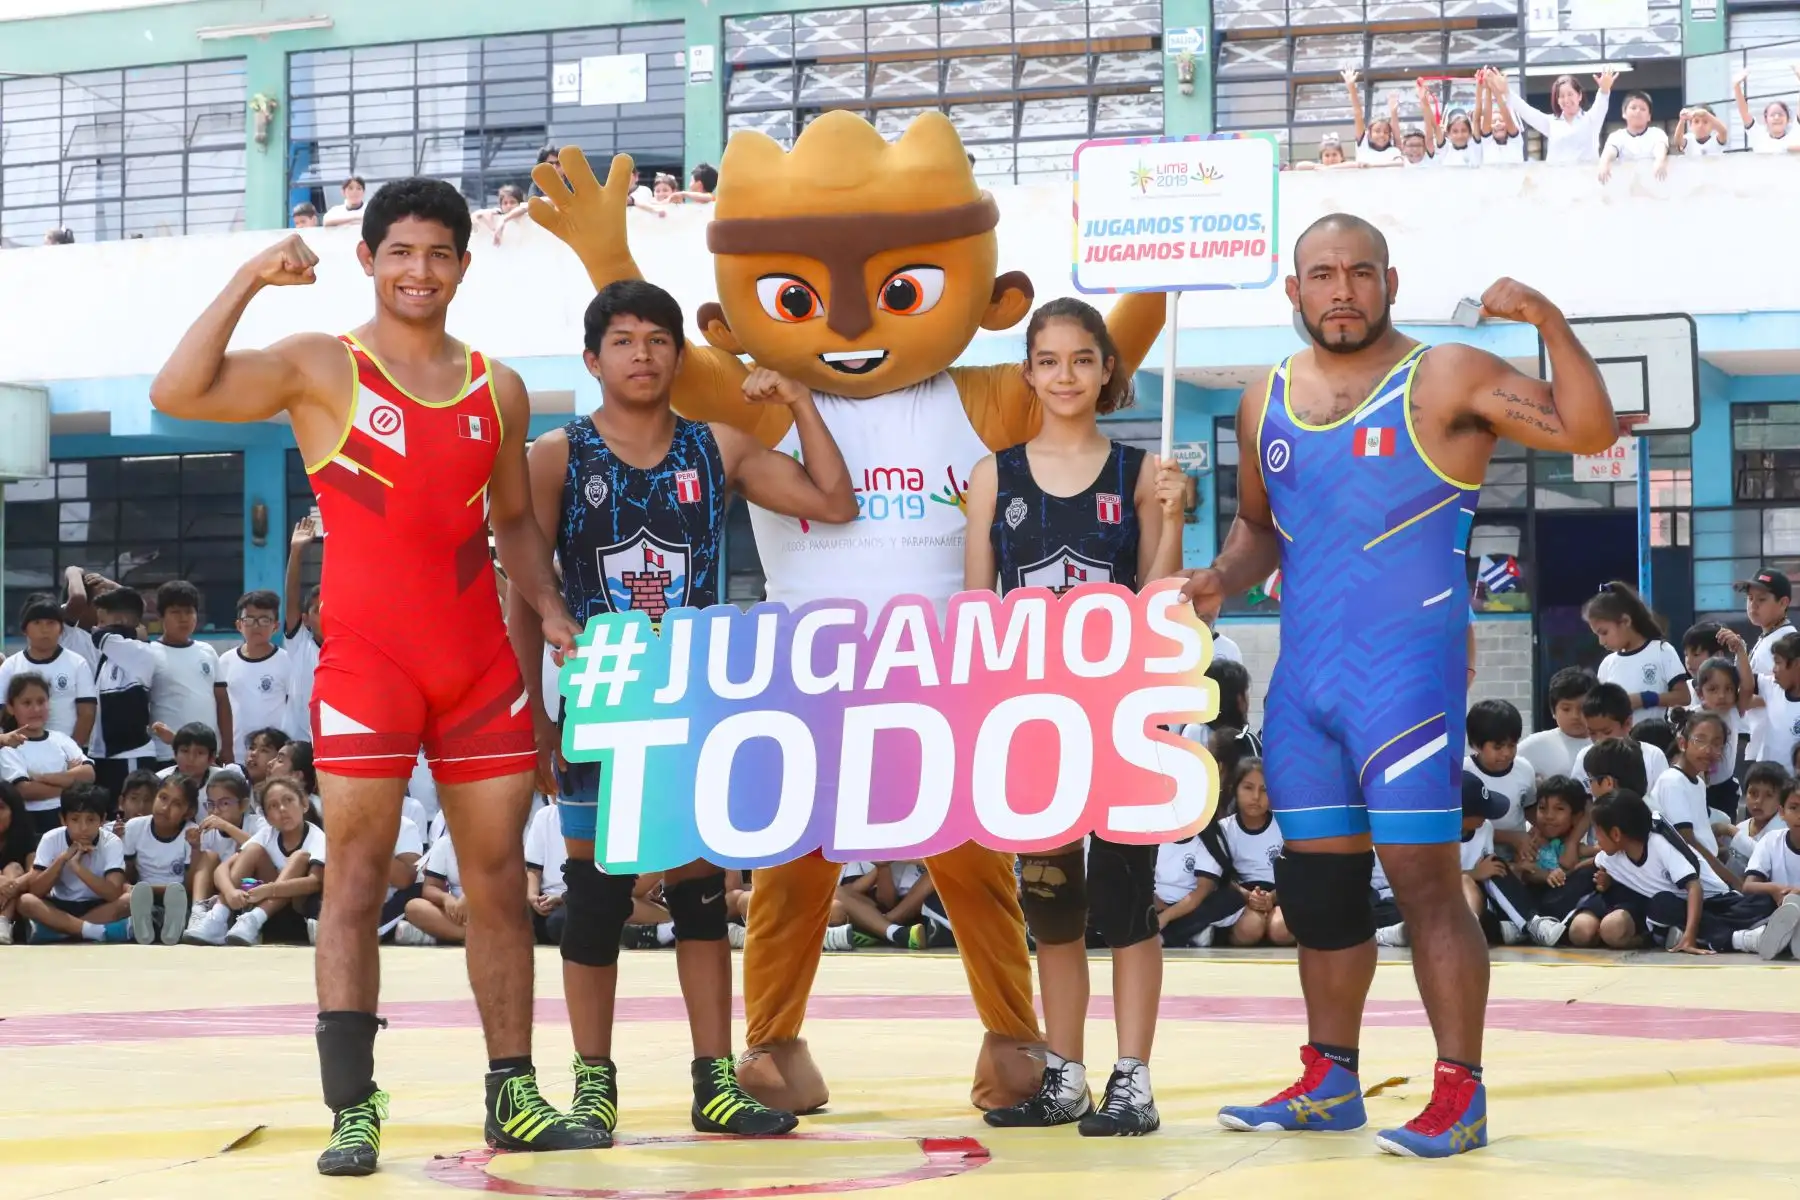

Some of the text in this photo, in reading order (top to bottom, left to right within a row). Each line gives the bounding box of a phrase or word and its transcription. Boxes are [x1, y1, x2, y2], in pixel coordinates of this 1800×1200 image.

[1157, 174, 1188, 187] 2019
[1084, 213, 1266, 238] JUGAMOS TODOS,
[1085, 239, 1266, 264] JUGAMOS LIMPIO
[677, 471, 696, 480] PERU
[1611, 461, 1621, 476] 8
[855, 494, 925, 520] 2019
[1099, 495, 1118, 503] PERU
[809, 537, 883, 552] PANAMERICANOS
[890, 536, 897, 547] Y
[569, 589, 1202, 708] #JUGAMOS
[573, 685, 1210, 863] TODOS
